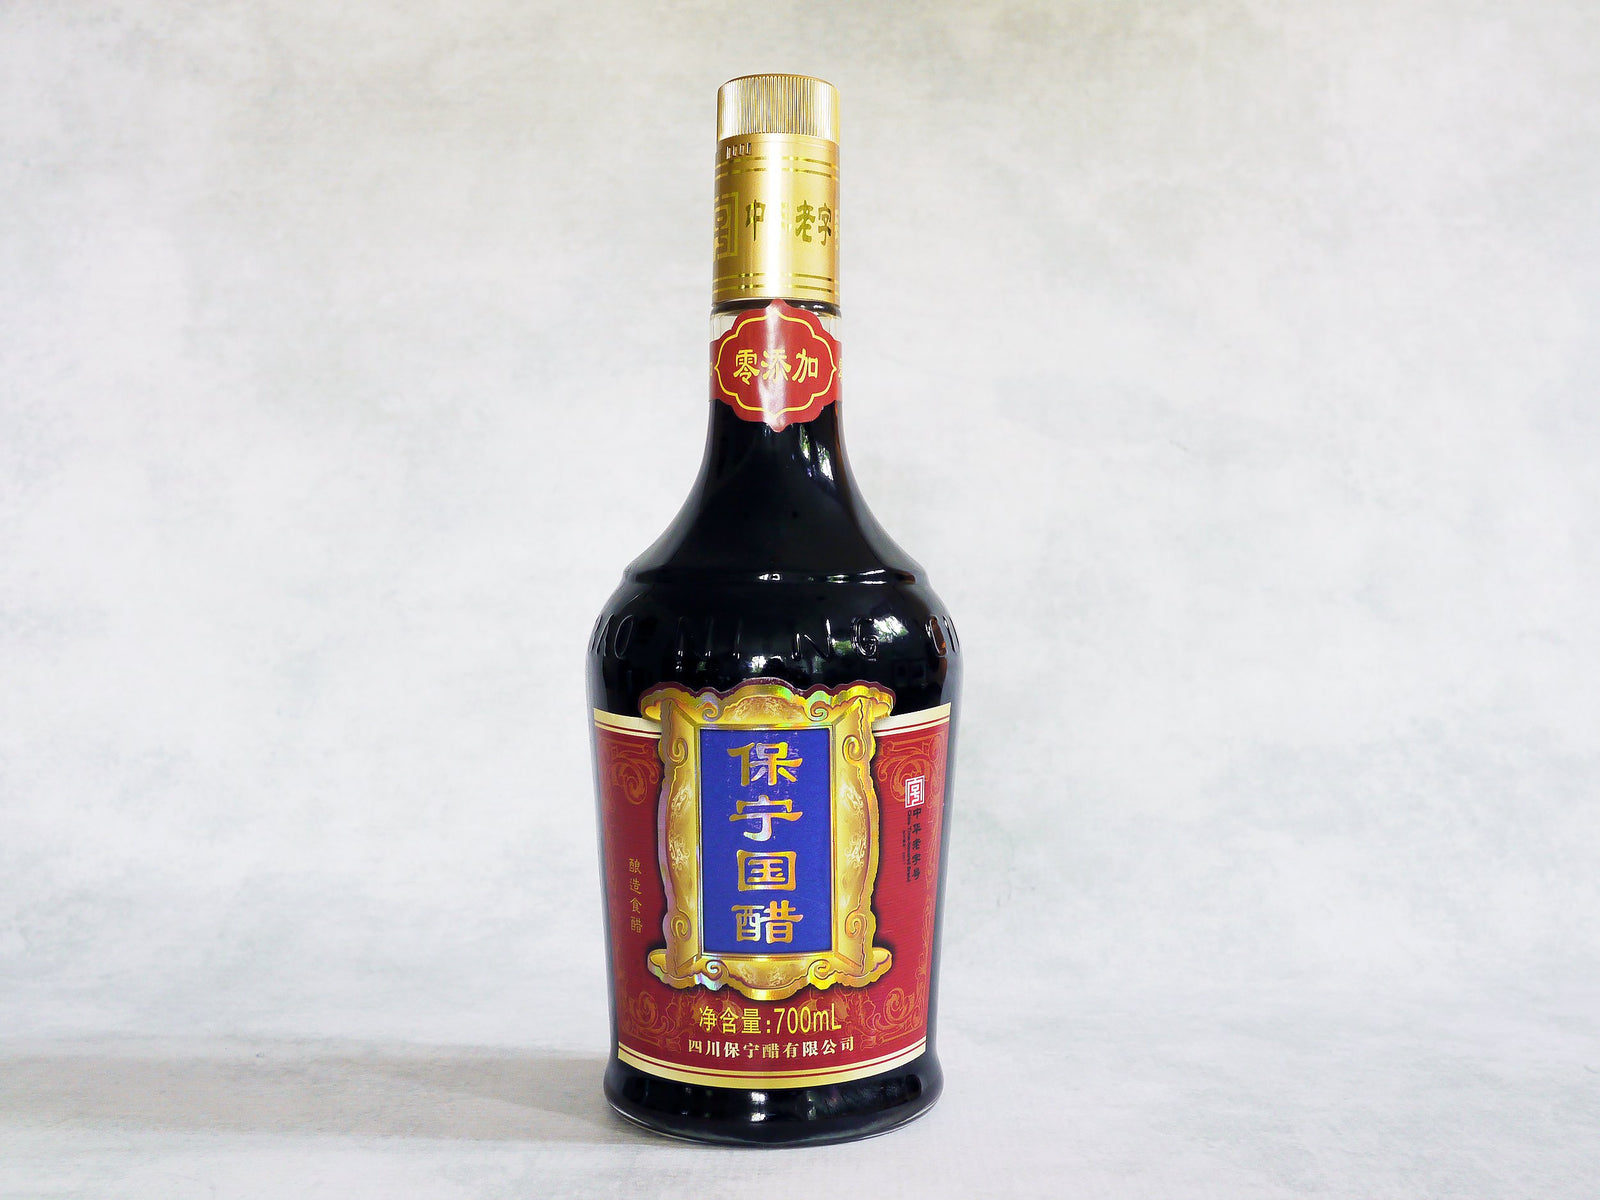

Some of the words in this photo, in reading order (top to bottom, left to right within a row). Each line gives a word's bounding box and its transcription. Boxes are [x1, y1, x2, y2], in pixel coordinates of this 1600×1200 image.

[744, 199, 839, 247] 中老字
[733, 348, 819, 385] 零添加
[726, 741, 803, 944] 保宁国醋
[912, 807, 922, 880] 中华老字号
[628, 858, 643, 933] 酿造食醋
[688, 1036, 854, 1060] 四川保宁醋有限公司
